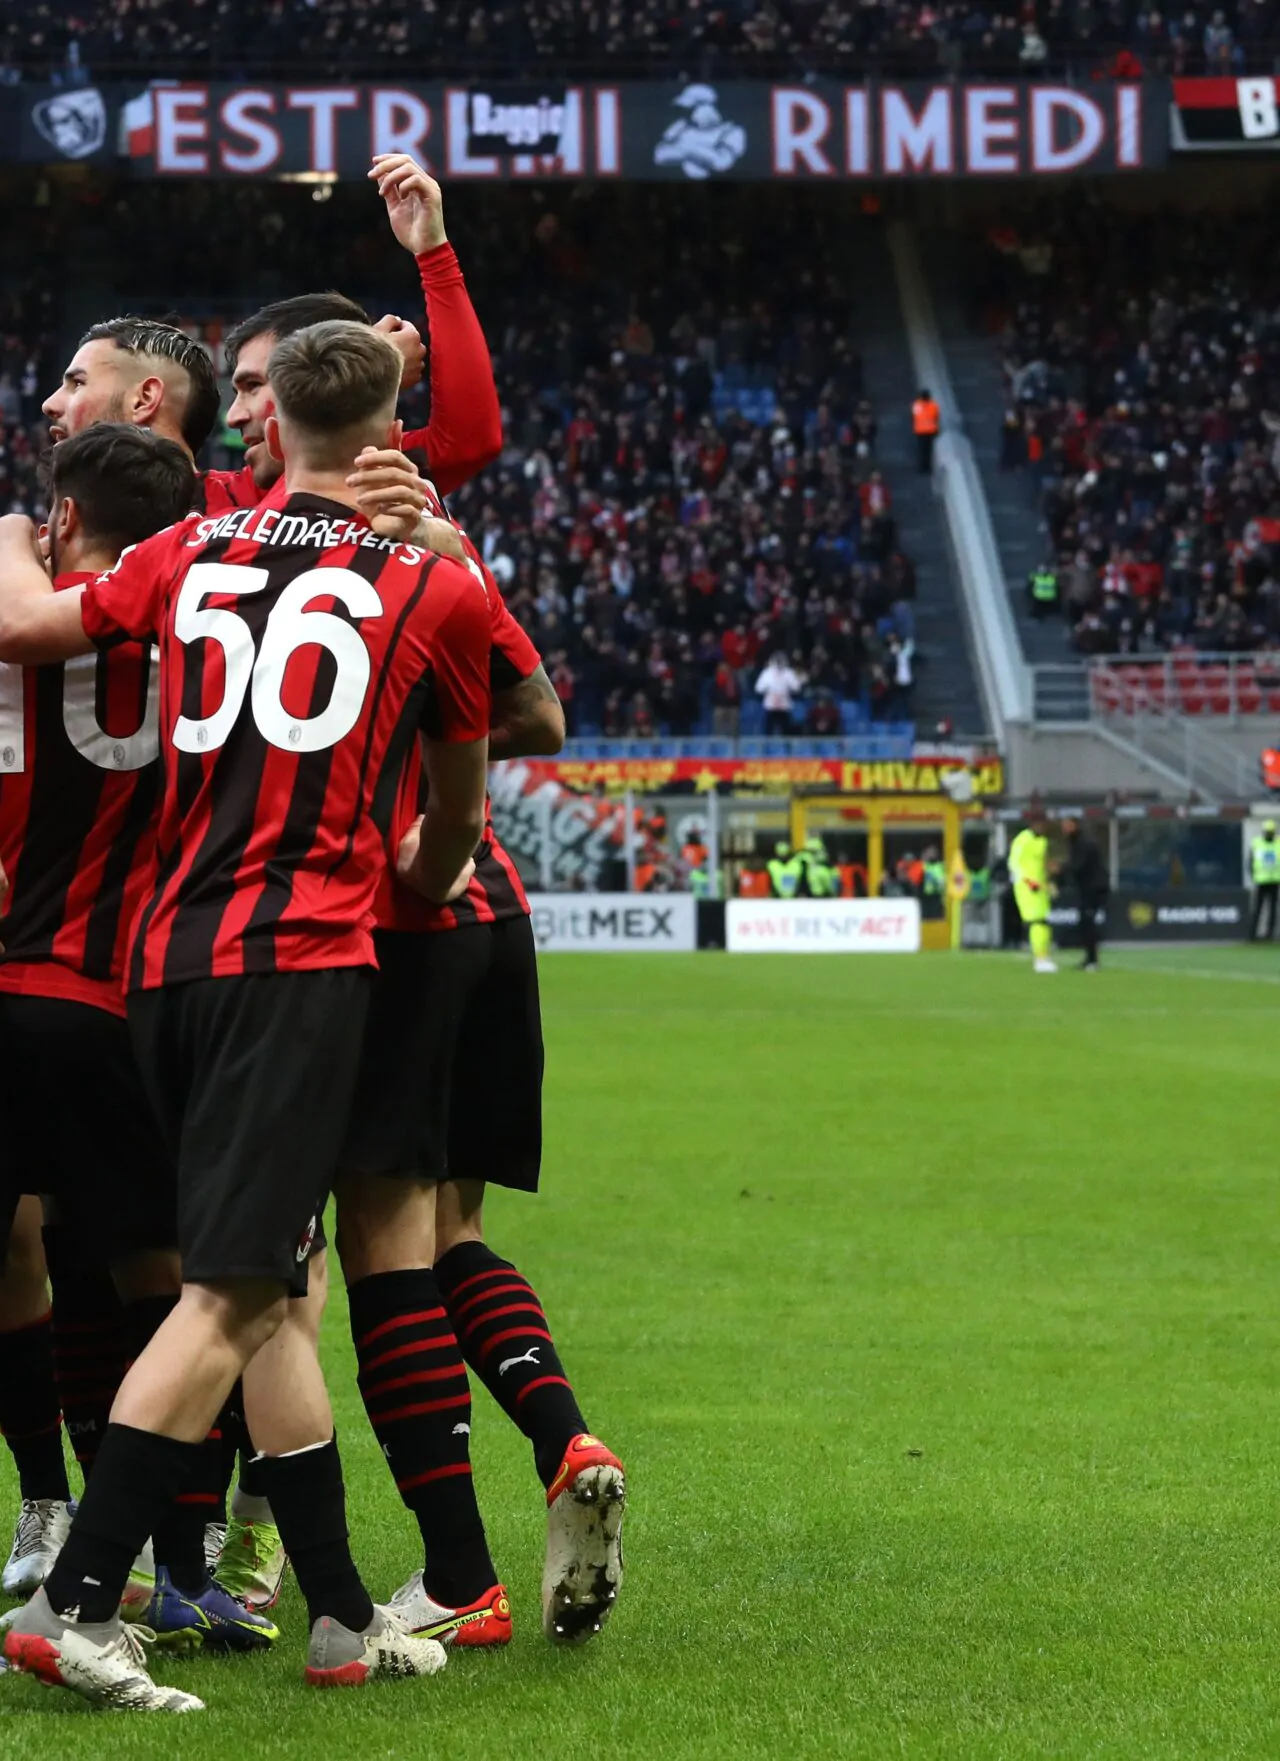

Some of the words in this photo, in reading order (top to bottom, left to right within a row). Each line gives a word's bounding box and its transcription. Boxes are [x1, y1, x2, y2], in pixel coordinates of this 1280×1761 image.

[472, 94, 564, 146] Baggio
[772, 85, 1142, 176] RIMEDI
[171, 562, 384, 754] 56
[534, 907, 674, 938] BitMEX
[453, 1612, 485, 1628] TIEMPO
